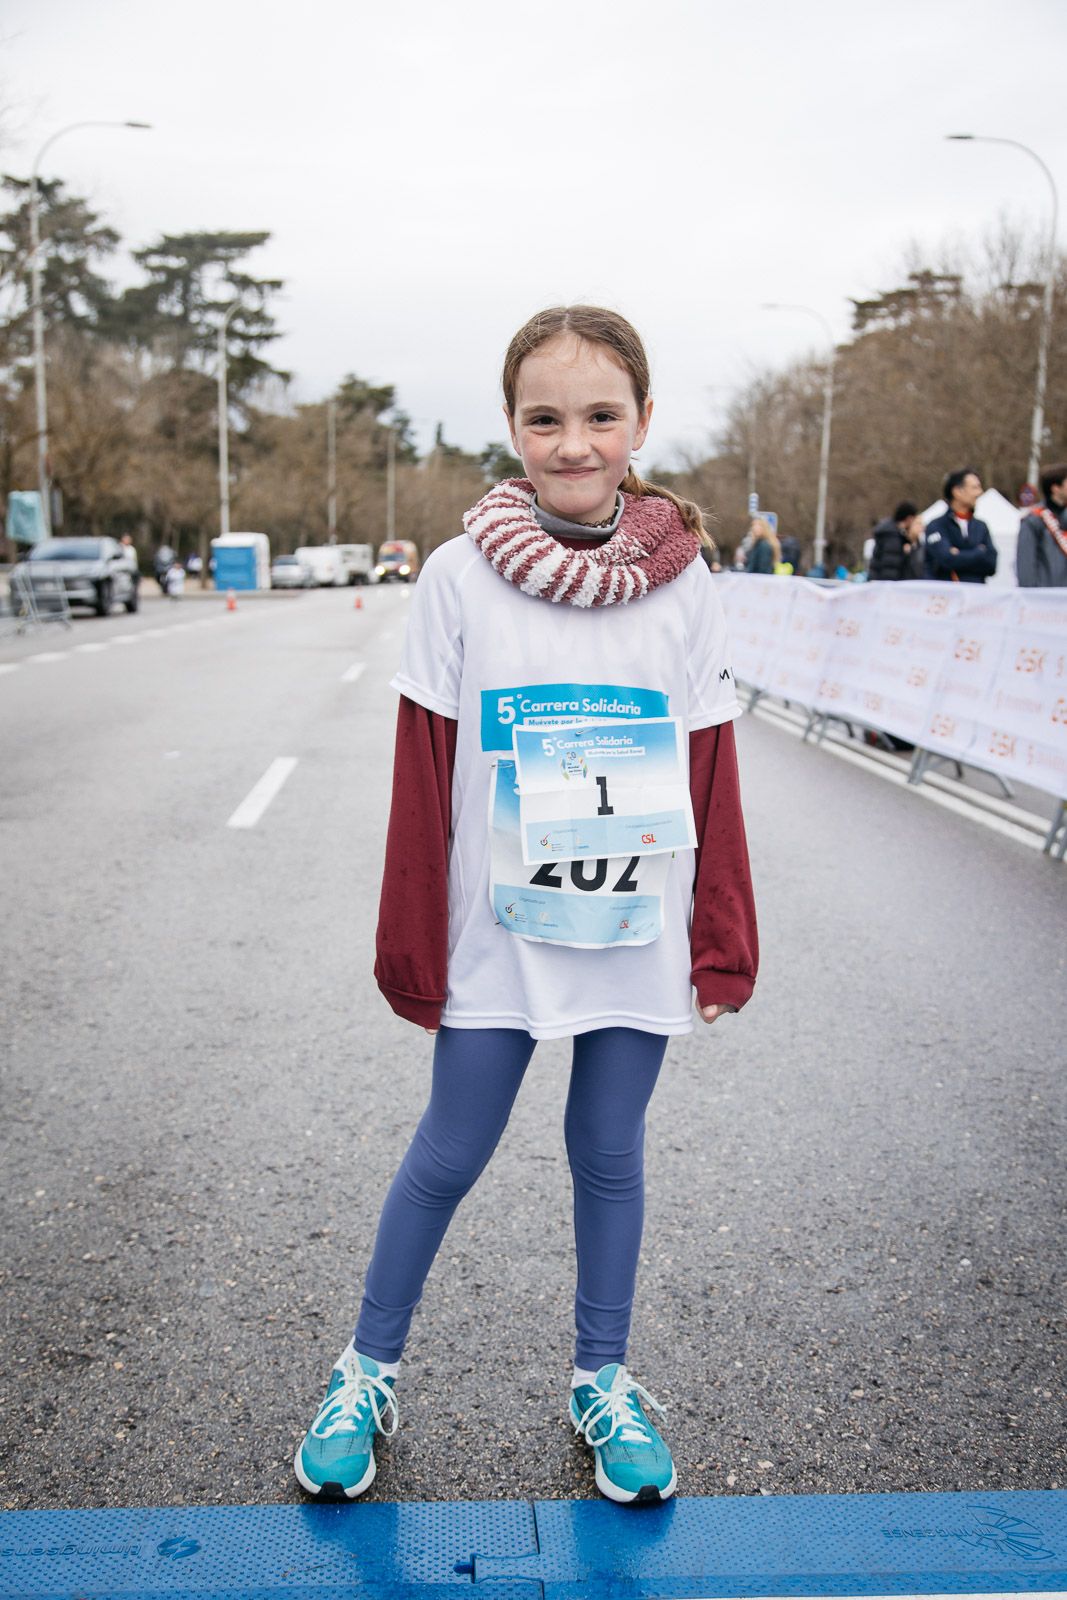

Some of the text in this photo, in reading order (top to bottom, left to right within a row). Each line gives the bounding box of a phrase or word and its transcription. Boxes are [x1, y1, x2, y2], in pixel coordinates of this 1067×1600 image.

[520, 699, 580, 713] Carrera
[582, 698, 641, 715] Solidaria
[528, 718, 559, 726] Muévete
[556, 738, 594, 749] Carrera
[595, 736, 633, 746] Solidaria
[595, 776, 614, 816] 1
[641, 834, 657, 844] CSL
